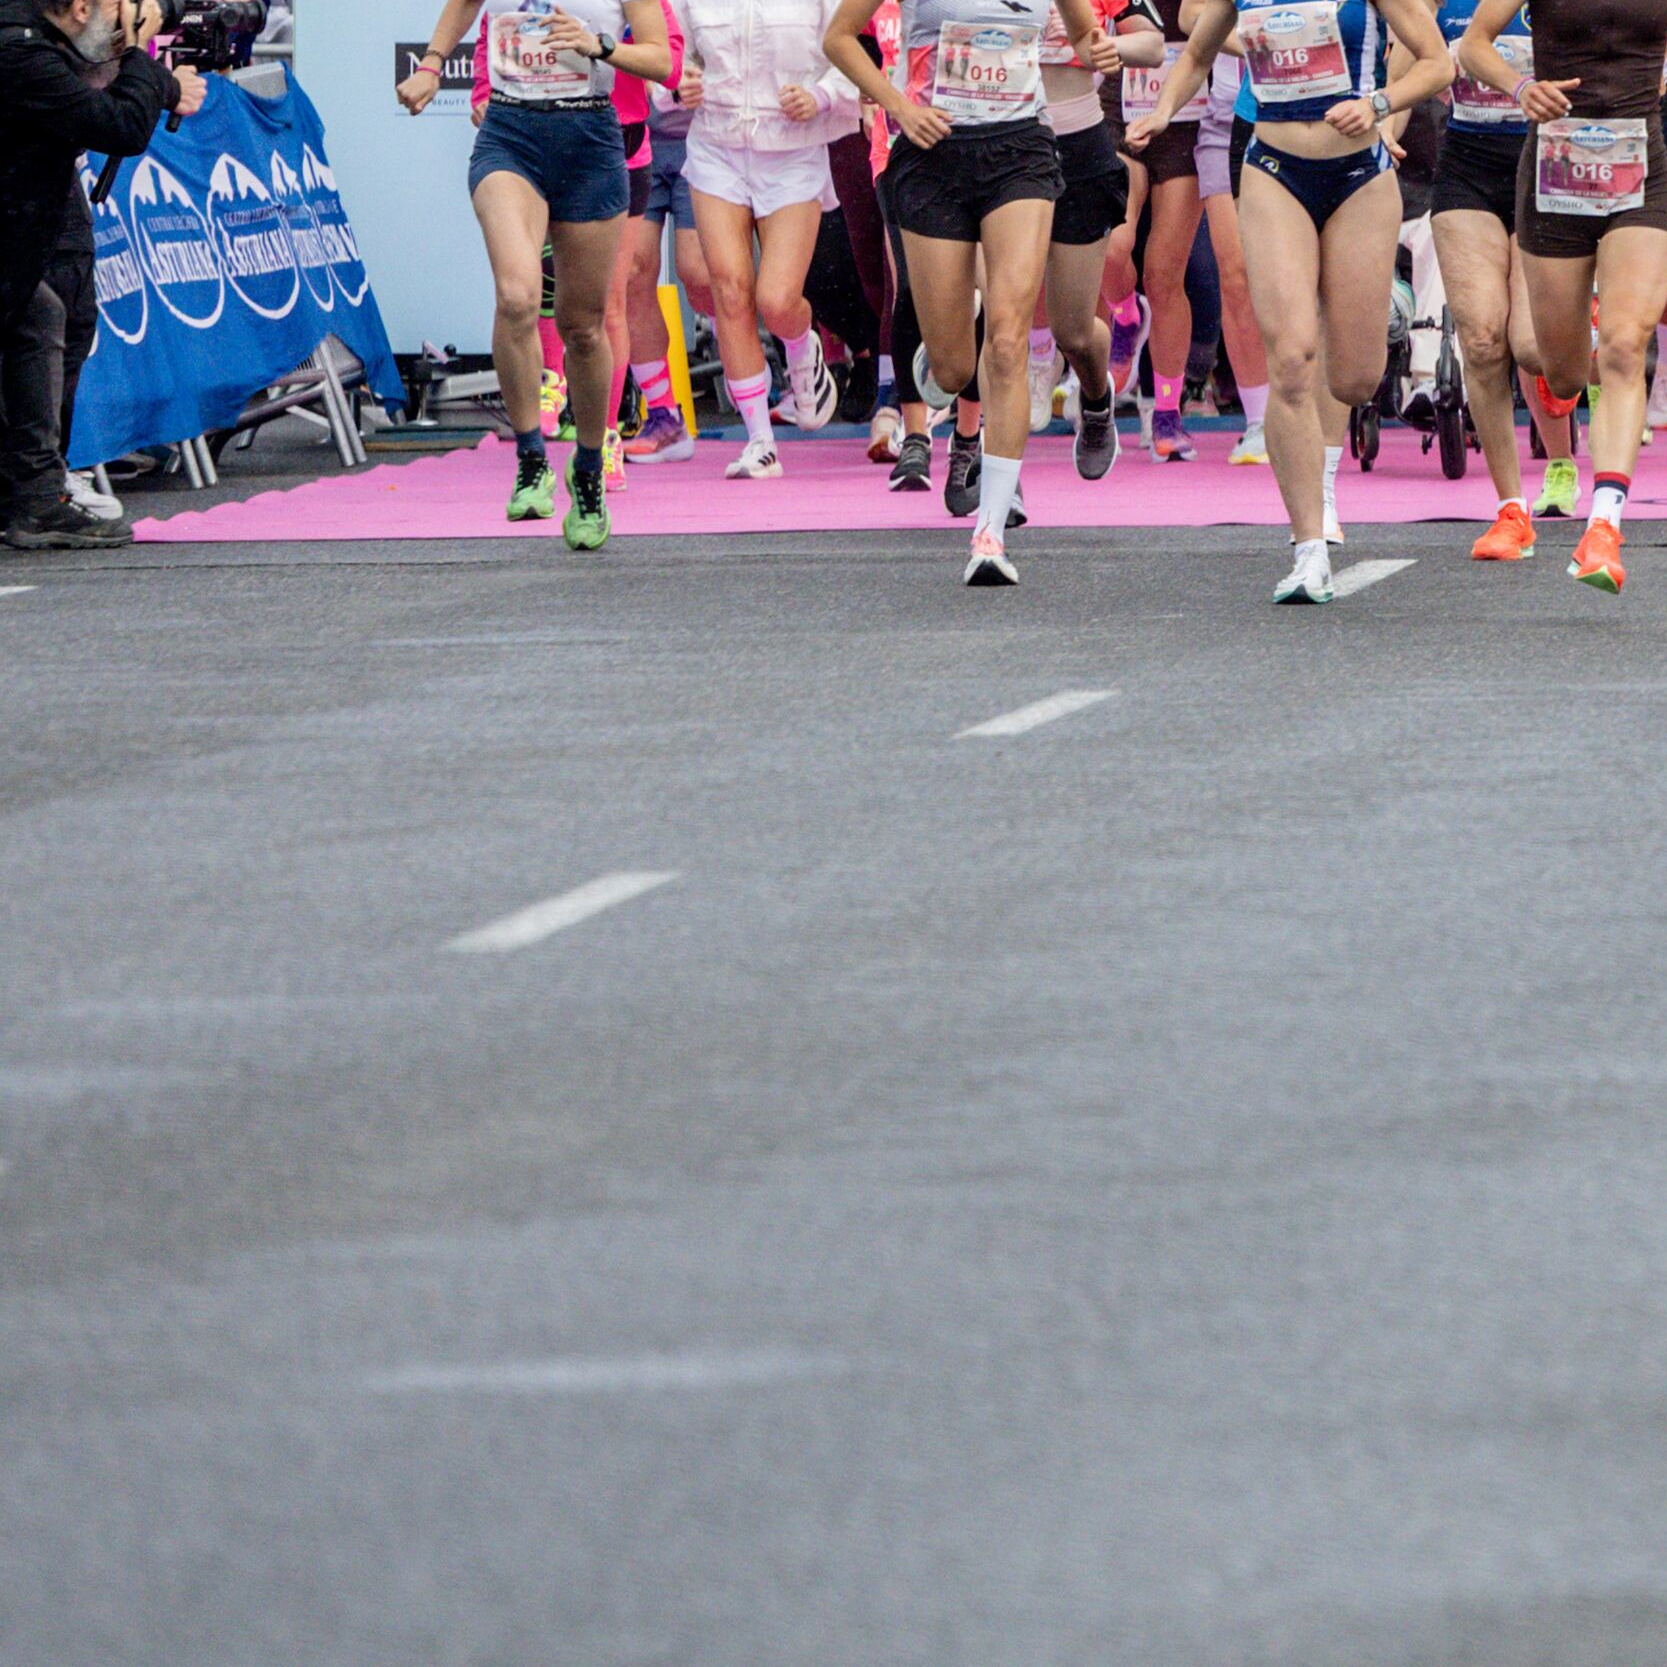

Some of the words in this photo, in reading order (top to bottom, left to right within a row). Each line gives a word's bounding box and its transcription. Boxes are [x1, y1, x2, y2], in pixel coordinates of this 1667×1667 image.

[522, 51, 558, 68] 016
[1272, 48, 1310, 66] 016
[970, 65, 1009, 83] 016
[1572, 163, 1614, 181] 016
